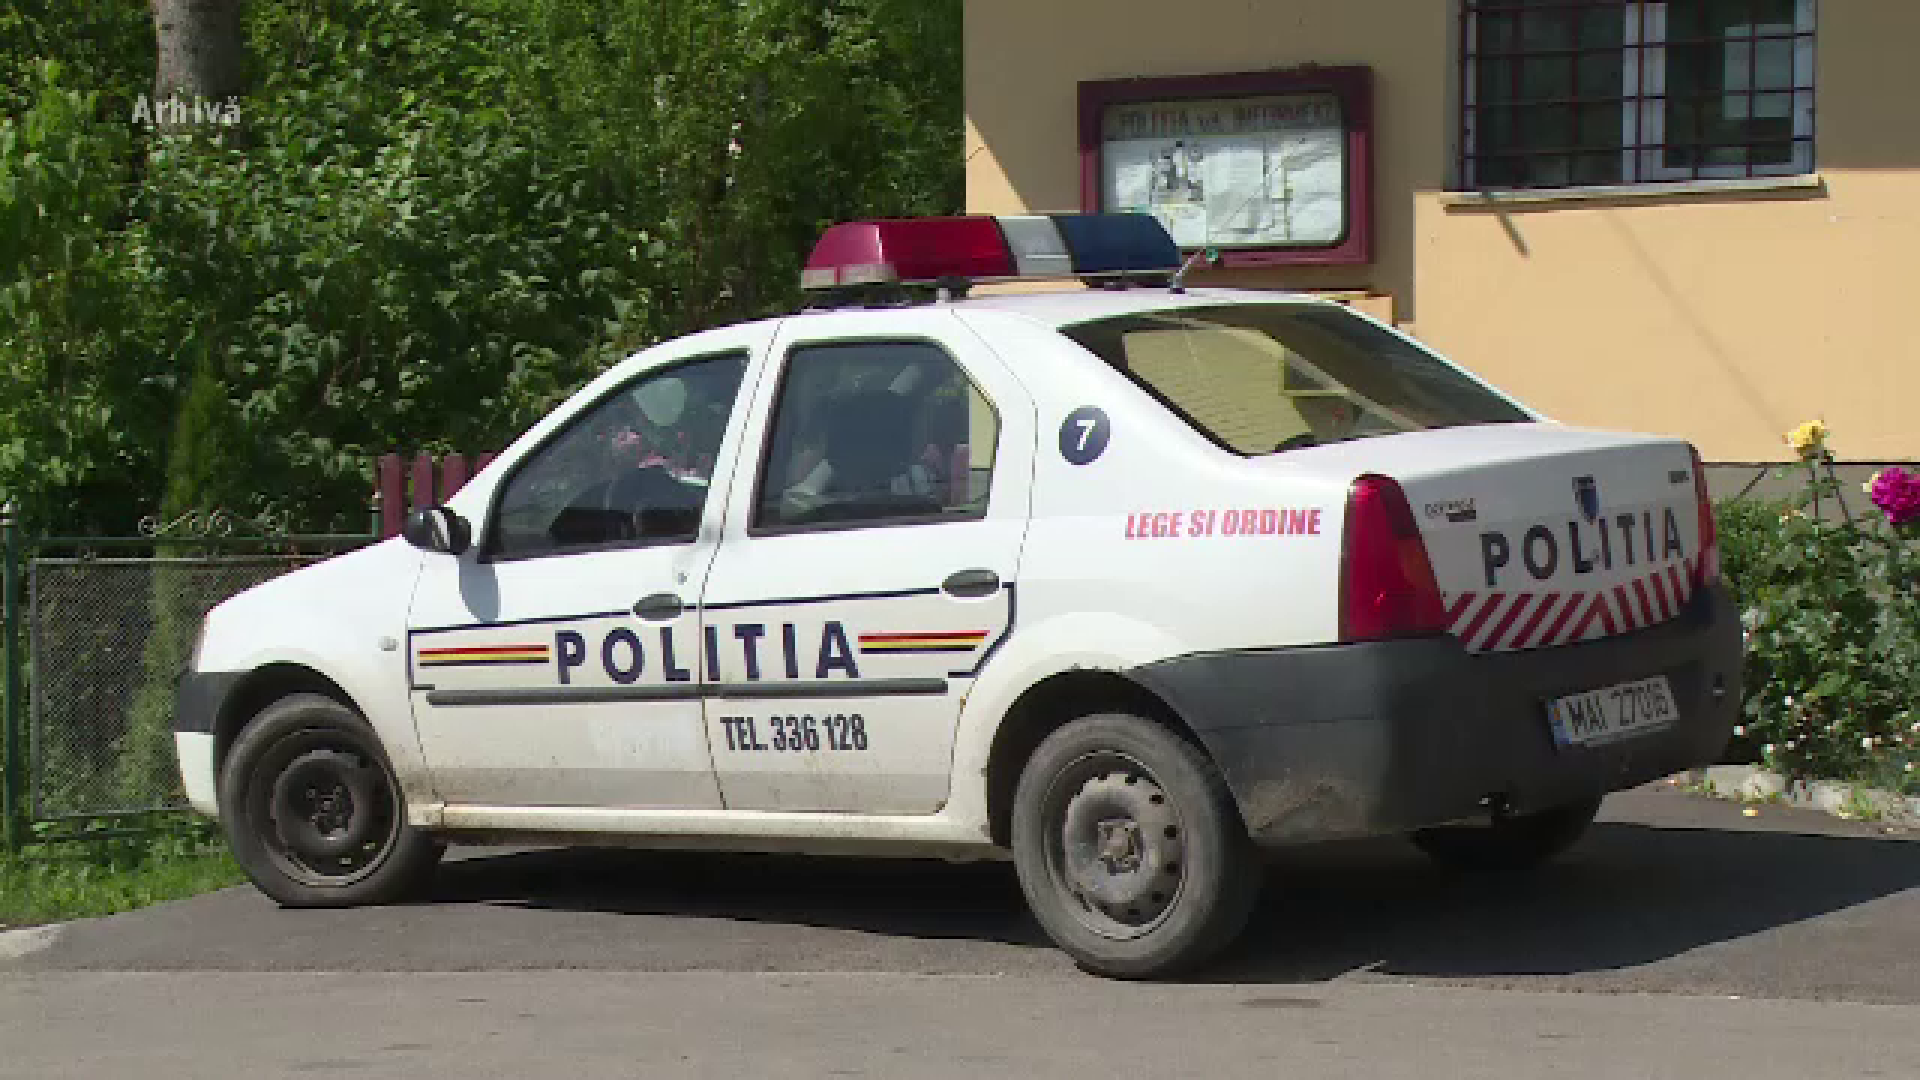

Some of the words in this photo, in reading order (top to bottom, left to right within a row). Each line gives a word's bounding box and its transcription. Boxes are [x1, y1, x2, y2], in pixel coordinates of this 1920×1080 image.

[1075, 419, 1096, 451] 7
[1125, 512, 1183, 540] LEGE
[1187, 509, 1216, 537] SI
[1220, 507, 1323, 536] ORDINE
[1479, 506, 1684, 588] POLITIA
[555, 620, 860, 685] POLITIA
[720, 716, 768, 751] TEL.
[770, 714, 819, 751] 336
[823, 713, 868, 751] 128
[1565, 697, 1608, 736] MAI
